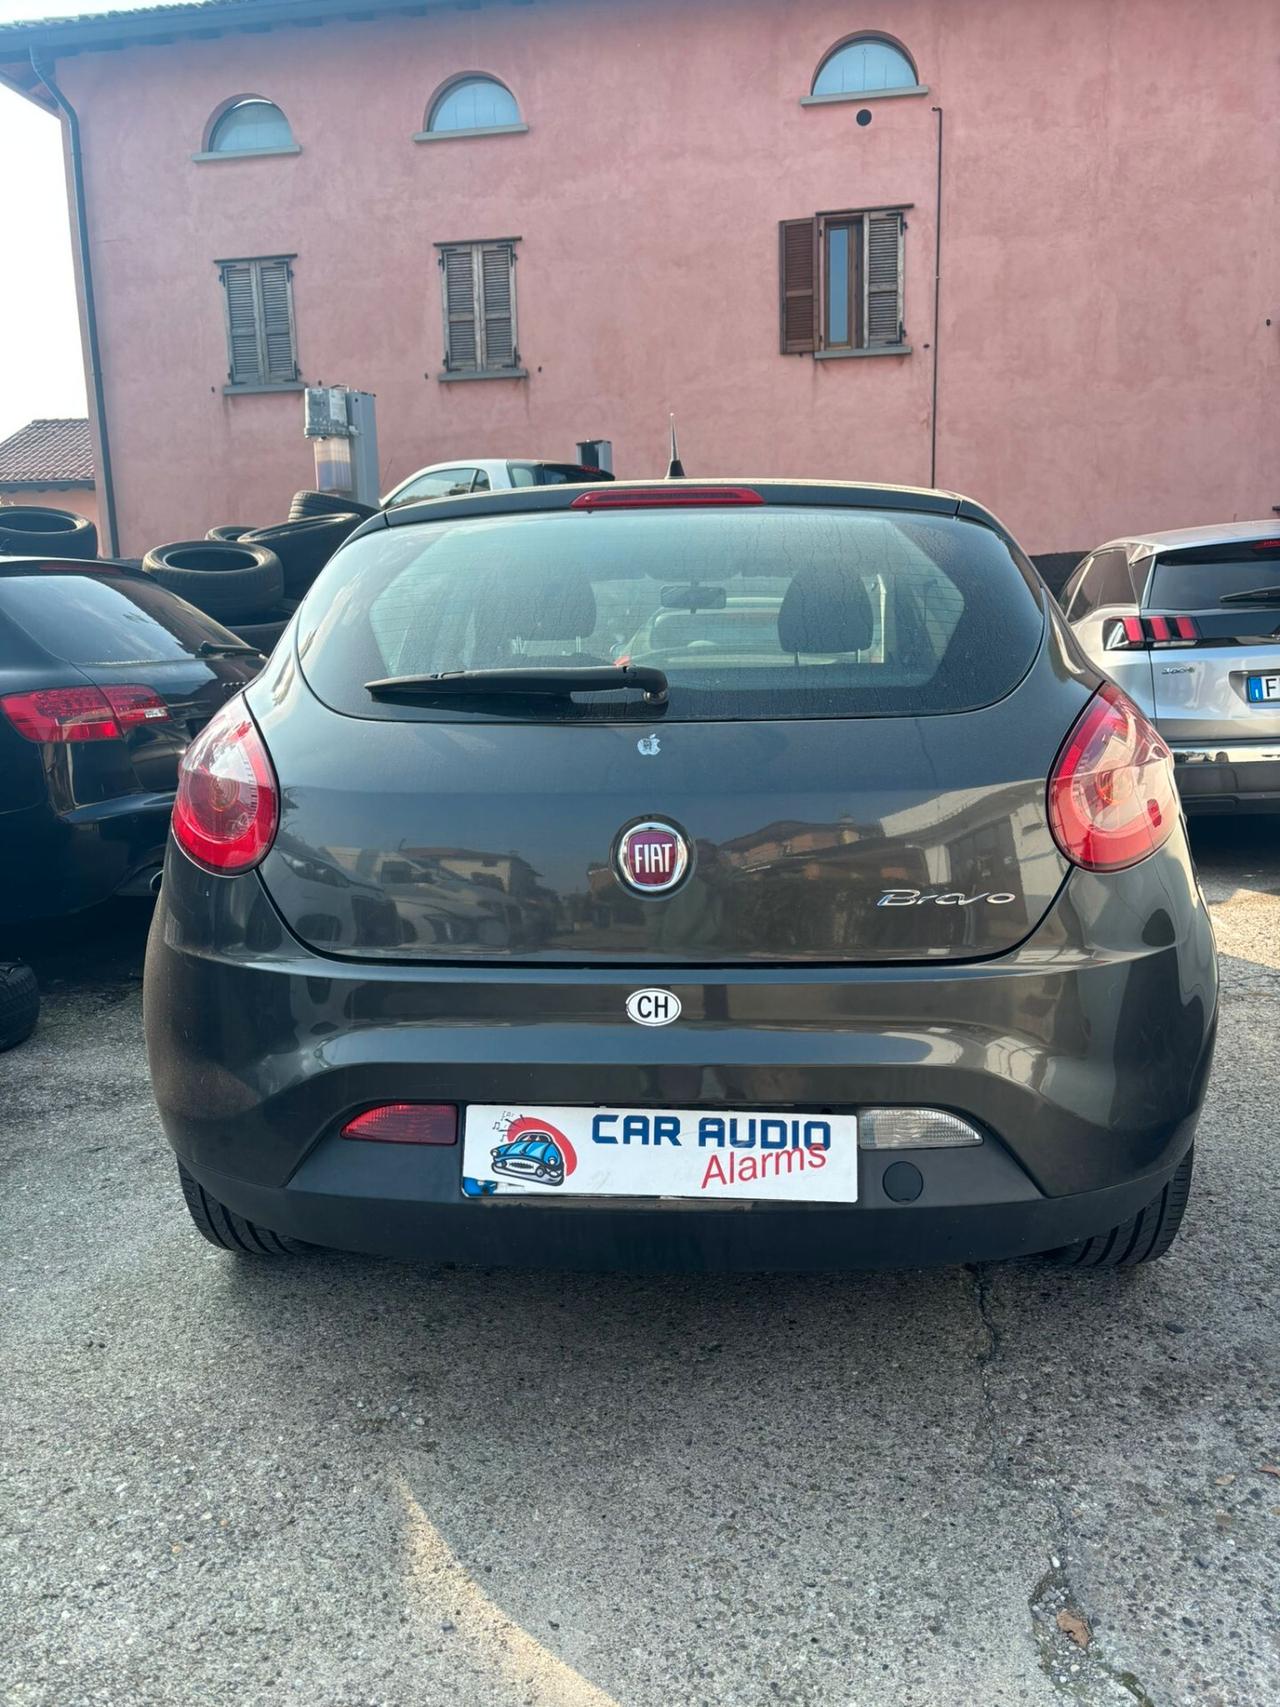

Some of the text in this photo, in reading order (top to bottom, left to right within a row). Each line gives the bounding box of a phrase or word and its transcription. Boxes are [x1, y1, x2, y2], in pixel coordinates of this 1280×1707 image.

[1265, 678, 1280, 697] F
[634, 843, 673, 874] FIAT
[877, 889, 1016, 906] Bravo
[636, 995, 669, 1019] CH
[592, 1114, 831, 1150] CAR AUDIO
[701, 1144, 827, 1189] Alarms
